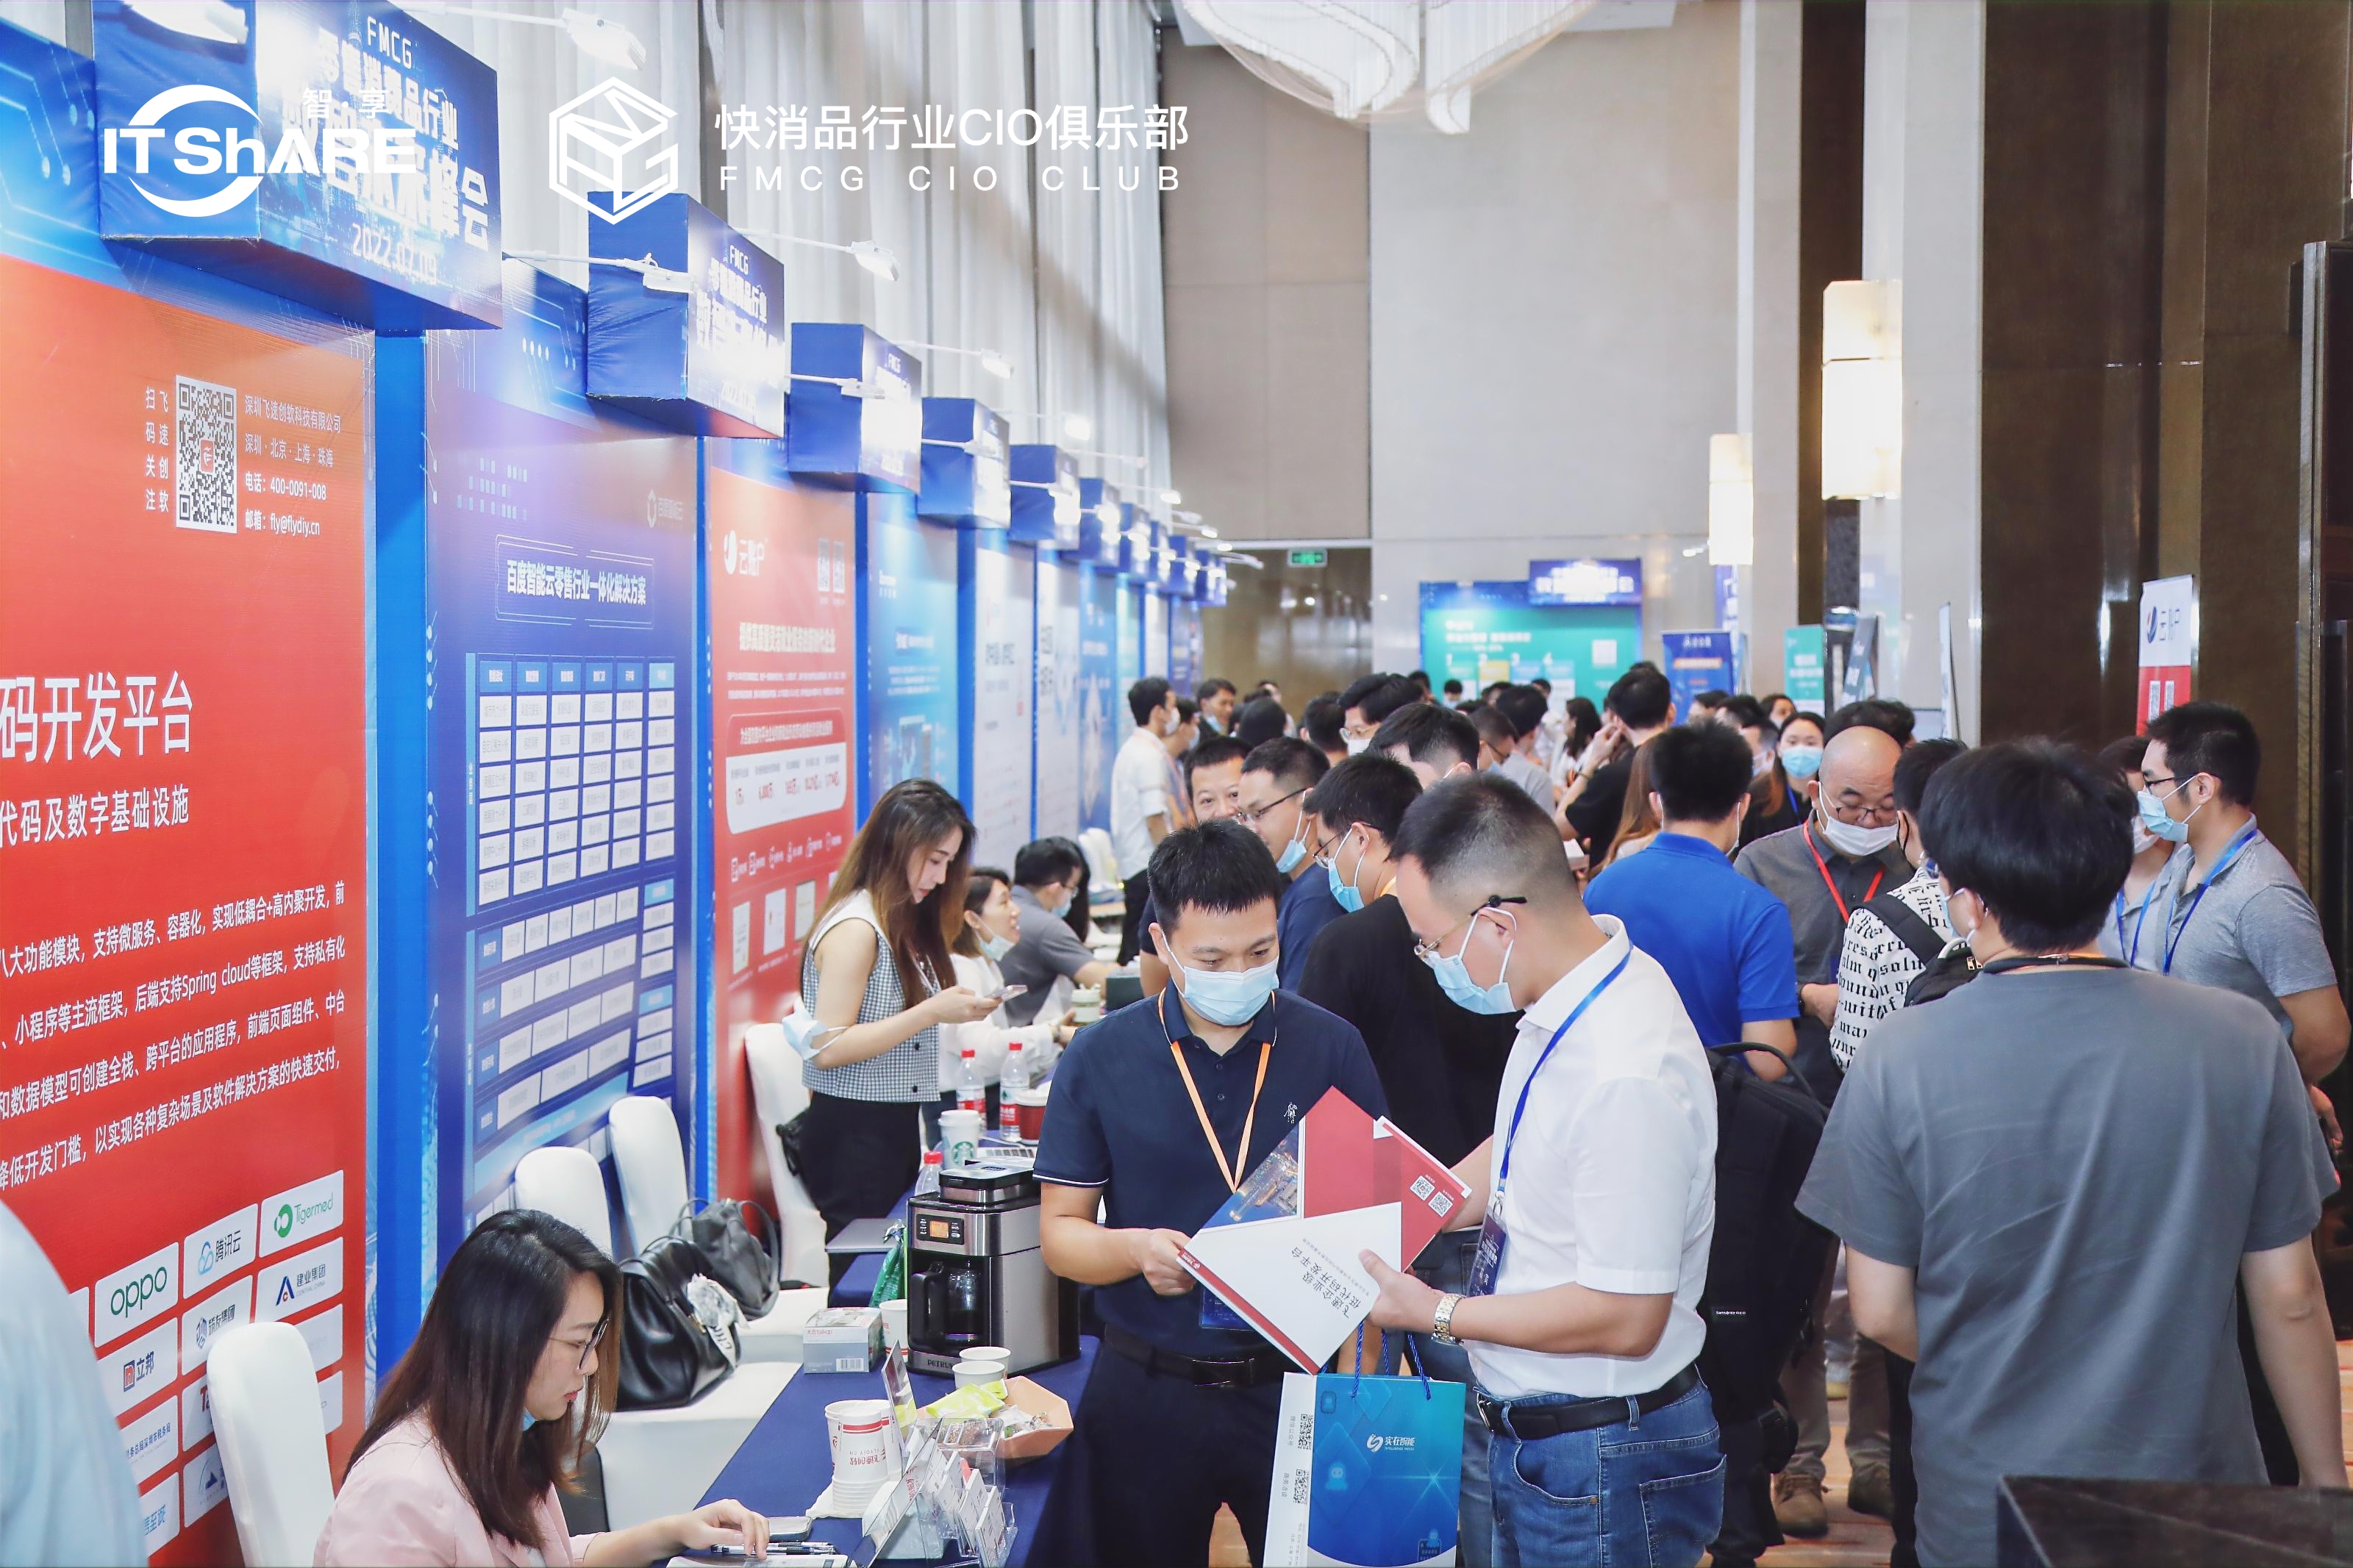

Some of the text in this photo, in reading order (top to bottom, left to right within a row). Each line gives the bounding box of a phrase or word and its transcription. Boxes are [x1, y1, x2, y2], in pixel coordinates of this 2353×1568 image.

[368, 16, 413, 70] FMCG
[245, 394, 341, 434] 深圳飞速创软科技有限公司
[507, 559, 646, 606] 百度智能云零售行业一体化解决方案
[0, 670, 193, 764] 码开发平台
[0, 784, 190, 849] 代码及数字基础设施
[294, 1192, 334, 1225] Tigermed
[215, 1230, 241, 1263] 腾讯云
[110, 1266, 168, 1318] oppo
[296, 1264, 326, 1287] 建业集团
[1292, 1246, 1360, 1309] 低代码开发平台
[136, 1350, 155, 1383] 立邦
[1384, 1436, 1415, 1447] 实在智能
